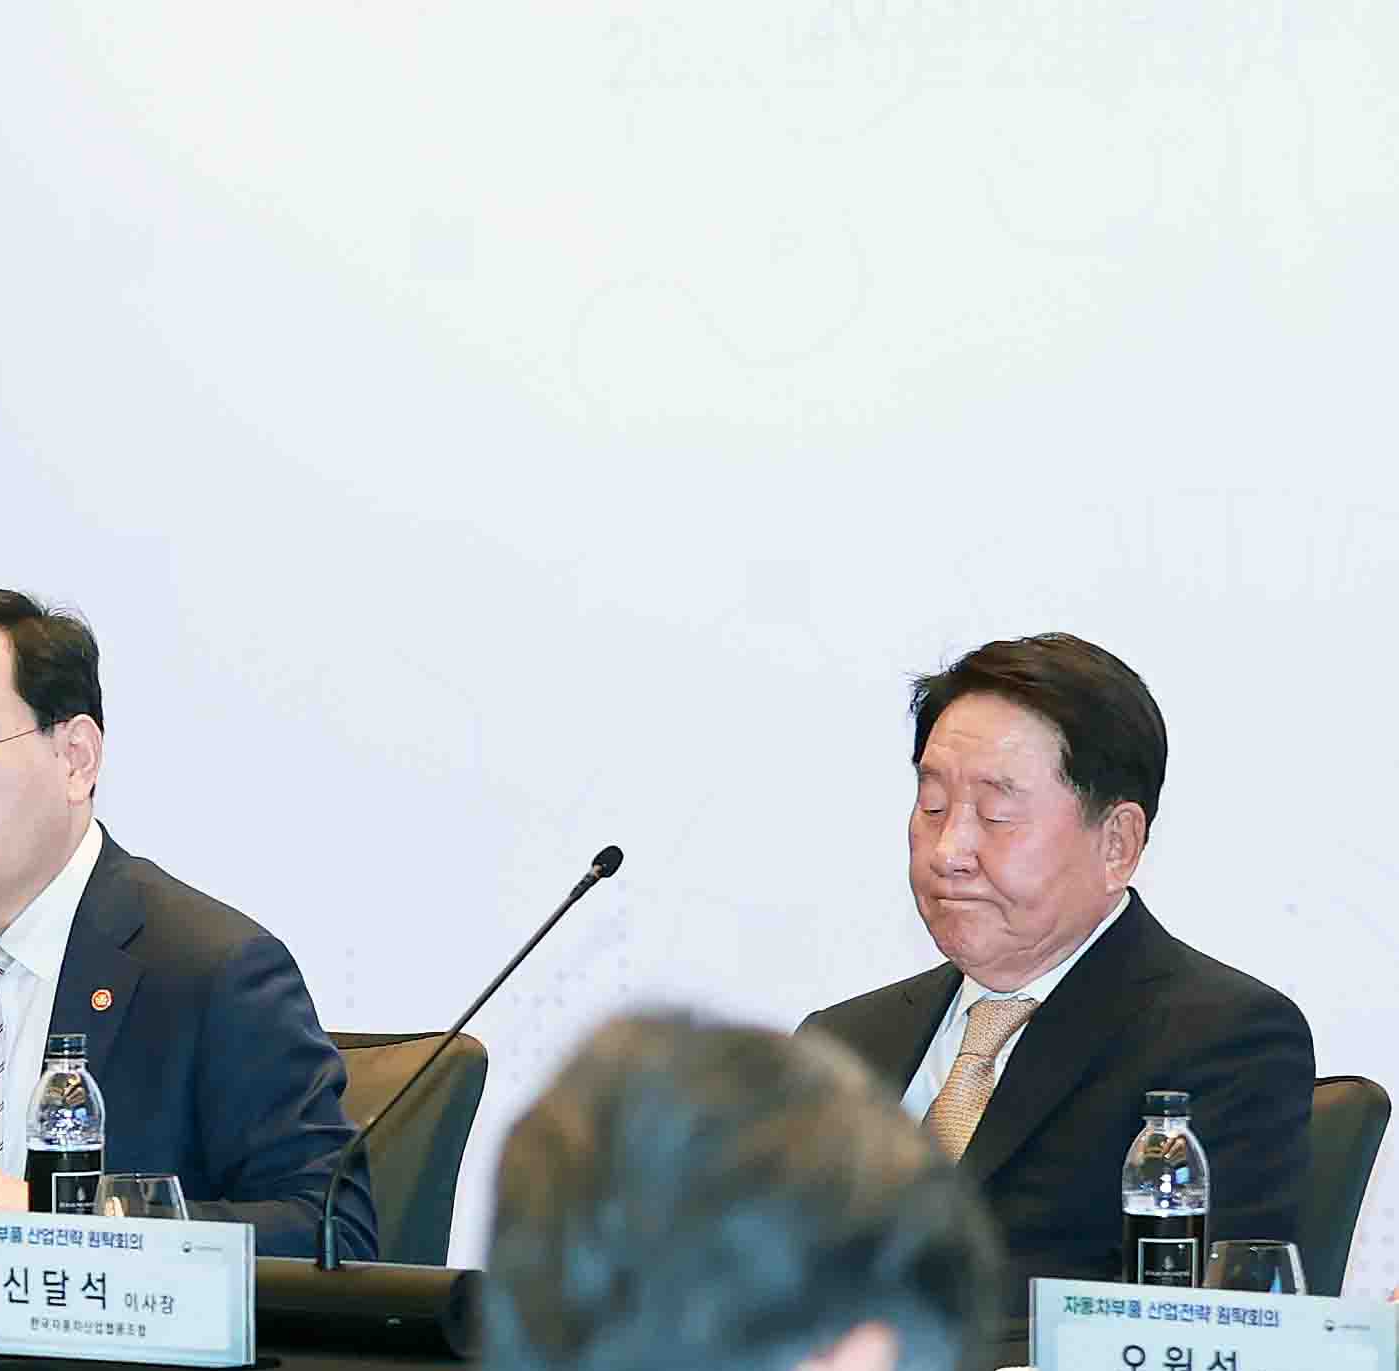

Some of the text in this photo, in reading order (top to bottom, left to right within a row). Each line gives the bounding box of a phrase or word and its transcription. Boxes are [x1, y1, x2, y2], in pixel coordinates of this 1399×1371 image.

[27, 1227, 83, 1247] 산업전략
[87, 1230, 144, 1251] 원탁회의
[3, 1265, 175, 1315] 신달석 이사장
[1063, 1294, 1281, 1328] 자동차부품 산업전략 원탁회의
